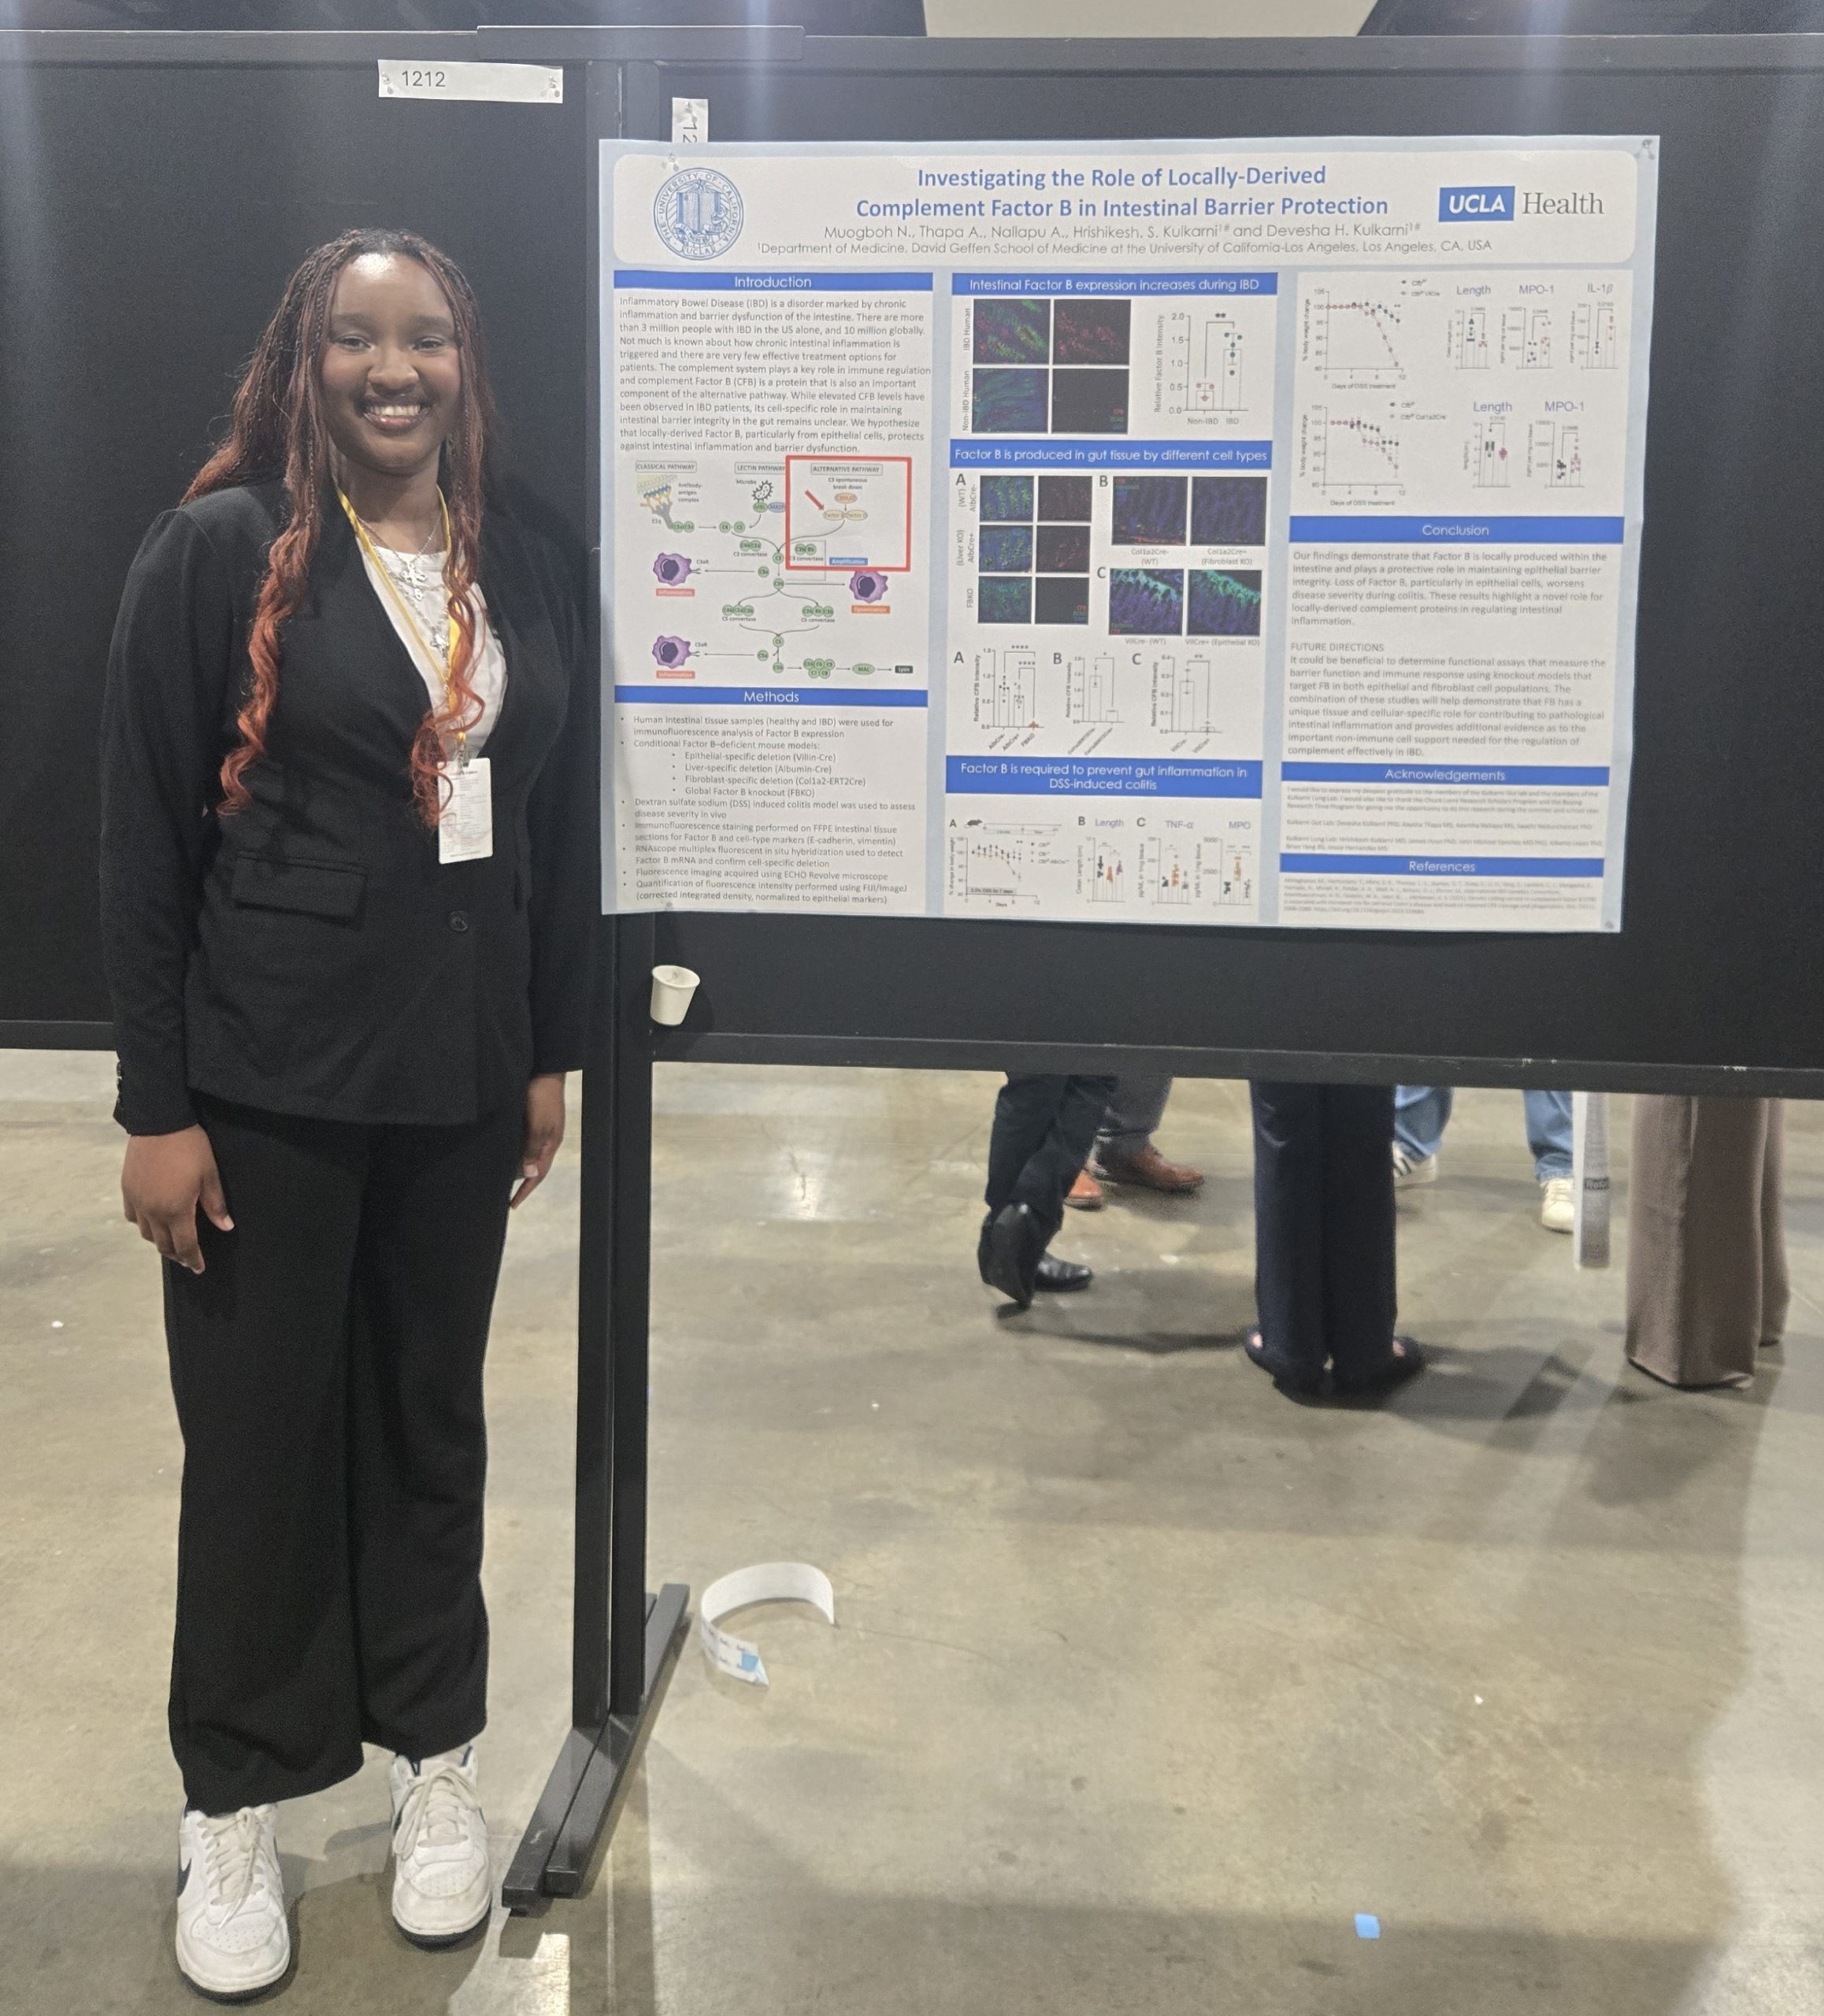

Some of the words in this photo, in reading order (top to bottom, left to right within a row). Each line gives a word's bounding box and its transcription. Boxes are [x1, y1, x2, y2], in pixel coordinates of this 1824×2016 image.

[401, 69, 445, 87] 1212
[705, 173, 718, 183] OF
[918, 169, 1045, 190] Investigating
[1051, 168, 1084, 186] the
[1092, 168, 1135, 187] Role
[1141, 168, 1162, 186] of
[1169, 165, 1325, 189] Locally-Derived
[659, 172, 699, 214] UNIVERSITY
[856, 198, 984, 220] Complement
[992, 199, 1053, 217] Factor
[1059, 199, 1071, 216] B
[1079, 198, 1096, 217] in
[1103, 197, 1197, 217] Intestinal
[1204, 197, 1274, 215] Barrier
[1281, 196, 1387, 214] Protection
[1449, 194, 1505, 213] UCLA
[1522, 191, 1603, 214] Health
[721, 185, 739, 242] CALIFORNIA
[660, 223, 672, 242] THE
[824, 224, 892, 241] Muogboh
[918, 224, 964, 240] Thapa
[991, 224, 1046, 240] Nallapu
[1147, 225, 1159, 238] S.
[1233, 224, 1262, 237] and
[1266, 223, 1330, 236] Devesha
[1334, 223, 1348, 235] H.
[835, 242, 847, 254] of
[911, 242, 946, 253] David
[949, 242, 991, 254] Geffen
[993, 243, 1033, 254] School
[1036, 242, 1049, 254] of
[1051, 243, 1107, 254] Medicine
[1110, 243, 1123, 254] at
[1126, 243, 1146, 254] the
[1149, 242, 1205, 255] University
[1207, 242, 1220, 253] of
[1222, 241, 1303, 253] California-Los
[1362, 241, 1381, 252] Los
[1467, 239, 1492, 250] USA
[735, 275, 811, 287] Introduction
[969, 280, 1021, 290] Intestinal
[1025, 279, 1062, 290] Factor
[1066, 279, 1072, 290] B
[1076, 280, 1136, 292] expression
[1140, 280, 1195, 290] increases
[1198, 279, 1236, 292] during
[1240, 279, 1259, 289] IBD
[1456, 284, 1491, 297] Length
[1518, 284, 1554, 295] MPO-1
[620, 296, 679, 308] Inflammatory
[681, 298, 708, 307] Bowel
[710, 298, 743, 307] Disease
[746, 298, 768, 309] (IBD)
[770, 298, 777, 307] is
[787, 298, 824, 307] disorder
[825, 298, 858, 308] marked
[861, 298, 872, 310] by
[873, 298, 906, 308] chronic
[1155, 315, 1165, 348] Intensity
[1154, 357, 1162, 380] Factor
[1153, 382, 1162, 412] Relative
[1473, 401, 1512, 414] Length
[1544, 400, 1584, 412] MPO-1
[955, 449, 992, 459] Factor
[994, 449, 1001, 459] B
[1004, 449, 1011, 459] is
[1014, 449, 1071, 461] produced
[1074, 449, 1084, 459] in
[1088, 450, 1107, 462] gut
[1110, 449, 1140, 460] tissue
[1144, 449, 1158, 462] by
[1161, 449, 1210, 460] different
[1212, 449, 1233, 460] cell
[1236, 450, 1267, 463] types
[955, 472, 966, 485] A
[1099, 475, 1108, 487] B
[1422, 523, 1489, 536] Conclusion
[1293, 550, 1311, 560] Our
[1312, 550, 1348, 561] findings
[1351, 550, 1410, 560] demonstrate
[1411, 551, 1430, 561] that
[1433, 551, 1462, 560] Factor
[1464, 551, 1470, 561] B
[1473, 551, 1480, 561] is
[1481, 551, 1511, 562] locally
[1513, 551, 1557, 562] produced
[1559, 552, 1589, 561] within
[1592, 551, 1607, 561] the
[1097, 566, 1106, 579] C
[1290, 642, 1326, 650] FUTURE
[1329, 642, 1384, 651] DIRECTIONS
[953, 650, 964, 663] A
[1053, 652, 1062, 664] B
[1131, 652, 1140, 665] C
[743, 690, 799, 702] Methods
[961, 762, 998, 773] Factor
[1000, 762, 1007, 773] B
[1010, 762, 1018, 773] is
[1020, 762, 1069, 776] required
[1072, 764, 1084, 775] to
[1087, 765, 1132, 778] prevent
[1135, 765, 1155, 778] gut
[1158, 765, 1233, 777] inflammation
[1236, 766, 1247, 778] in
[1385, 769, 1506, 782] Acknowledgements
[1049, 777, 1122, 789] DSS-induced
[1125, 778, 1157, 790] colitis
[684, 786, 711, 795] Global
[713, 787, 738, 795] Factor
[747, 788, 784, 796] knockout
[787, 788, 814, 798] (FBKO)
[949, 818, 957, 827] A
[1077, 815, 1085, 825] B
[1095, 818, 1124, 828] Length
[1136, 817, 1146, 827] C
[1409, 860, 1476, 873] References
